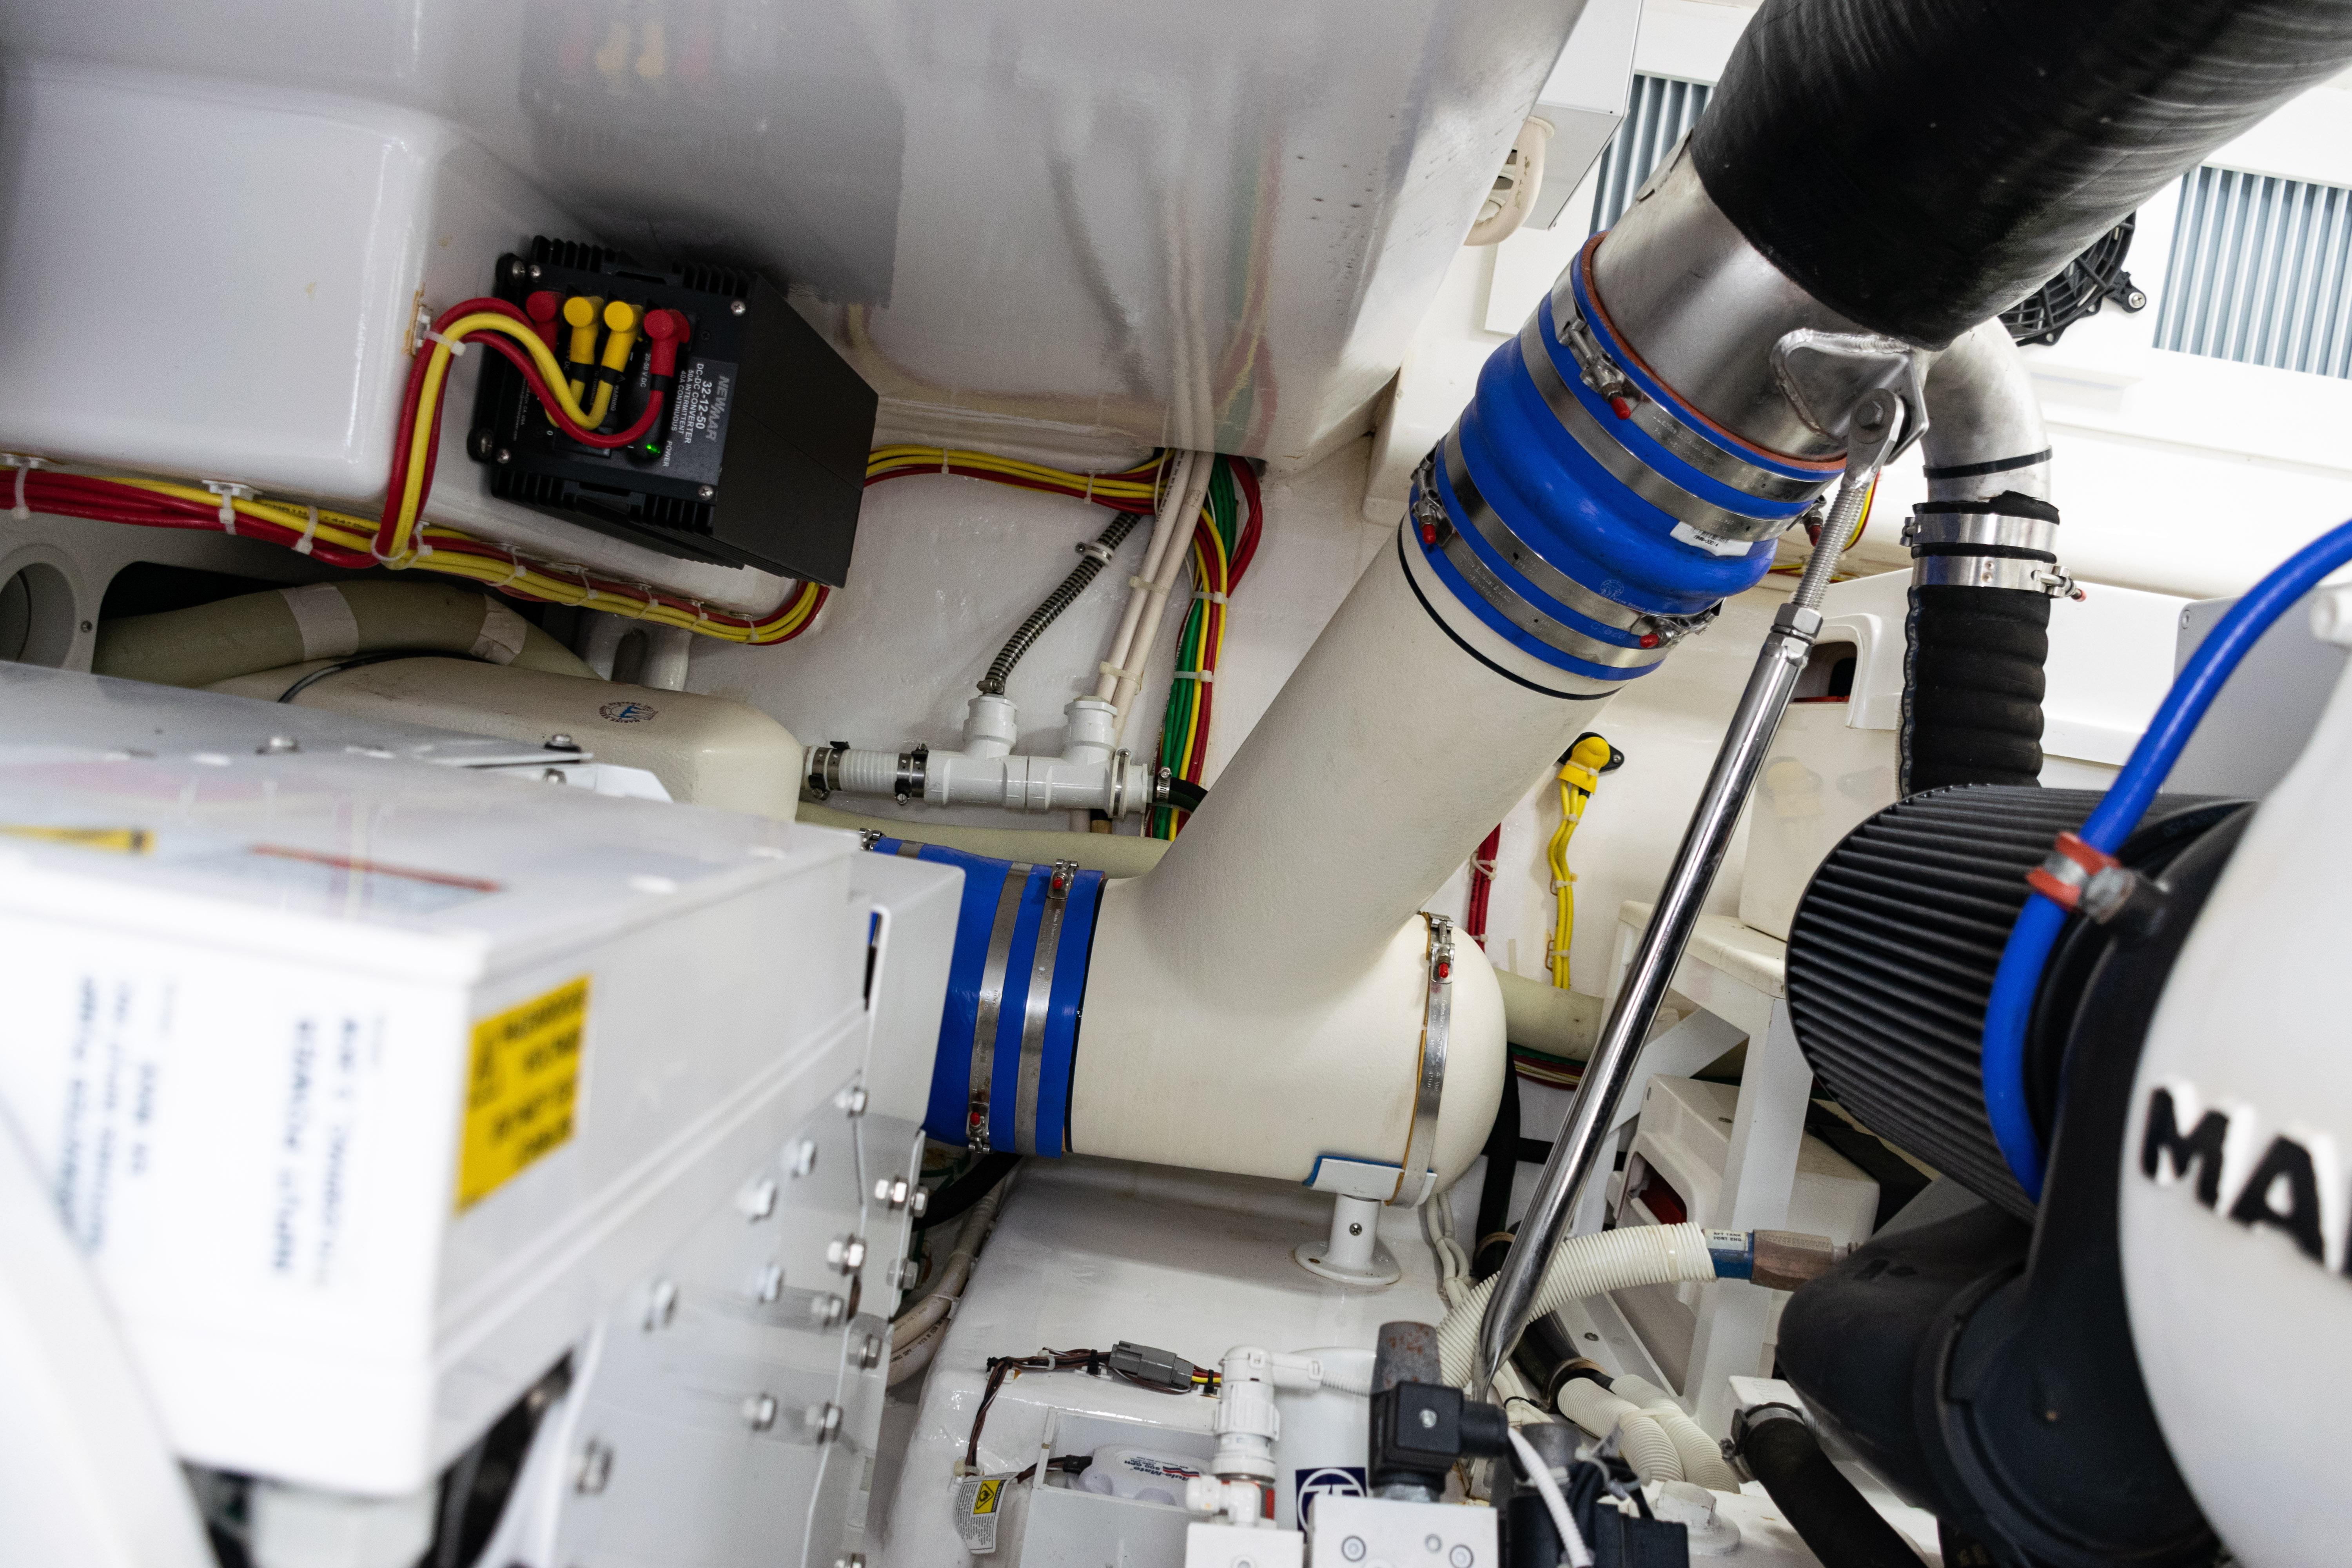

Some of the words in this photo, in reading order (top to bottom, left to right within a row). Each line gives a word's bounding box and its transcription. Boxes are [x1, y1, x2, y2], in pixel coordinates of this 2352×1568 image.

[610, 385, 619, 411] WARNING
[640, 378, 646, 387] DC
[693, 363, 704, 390] DC-DC
[671, 385, 683, 431] CONTINUOUS
[678, 384, 691, 434] INTERMITTENT
[684, 392, 699, 444] CONVERTER
[695, 381, 712, 429] 32-12-50
[705, 375, 730, 441] NEWMAR
[662, 441, 672, 467] POWER
[1903, 699, 1911, 717] ID
[2141, 1085, 2352, 1288] MA
